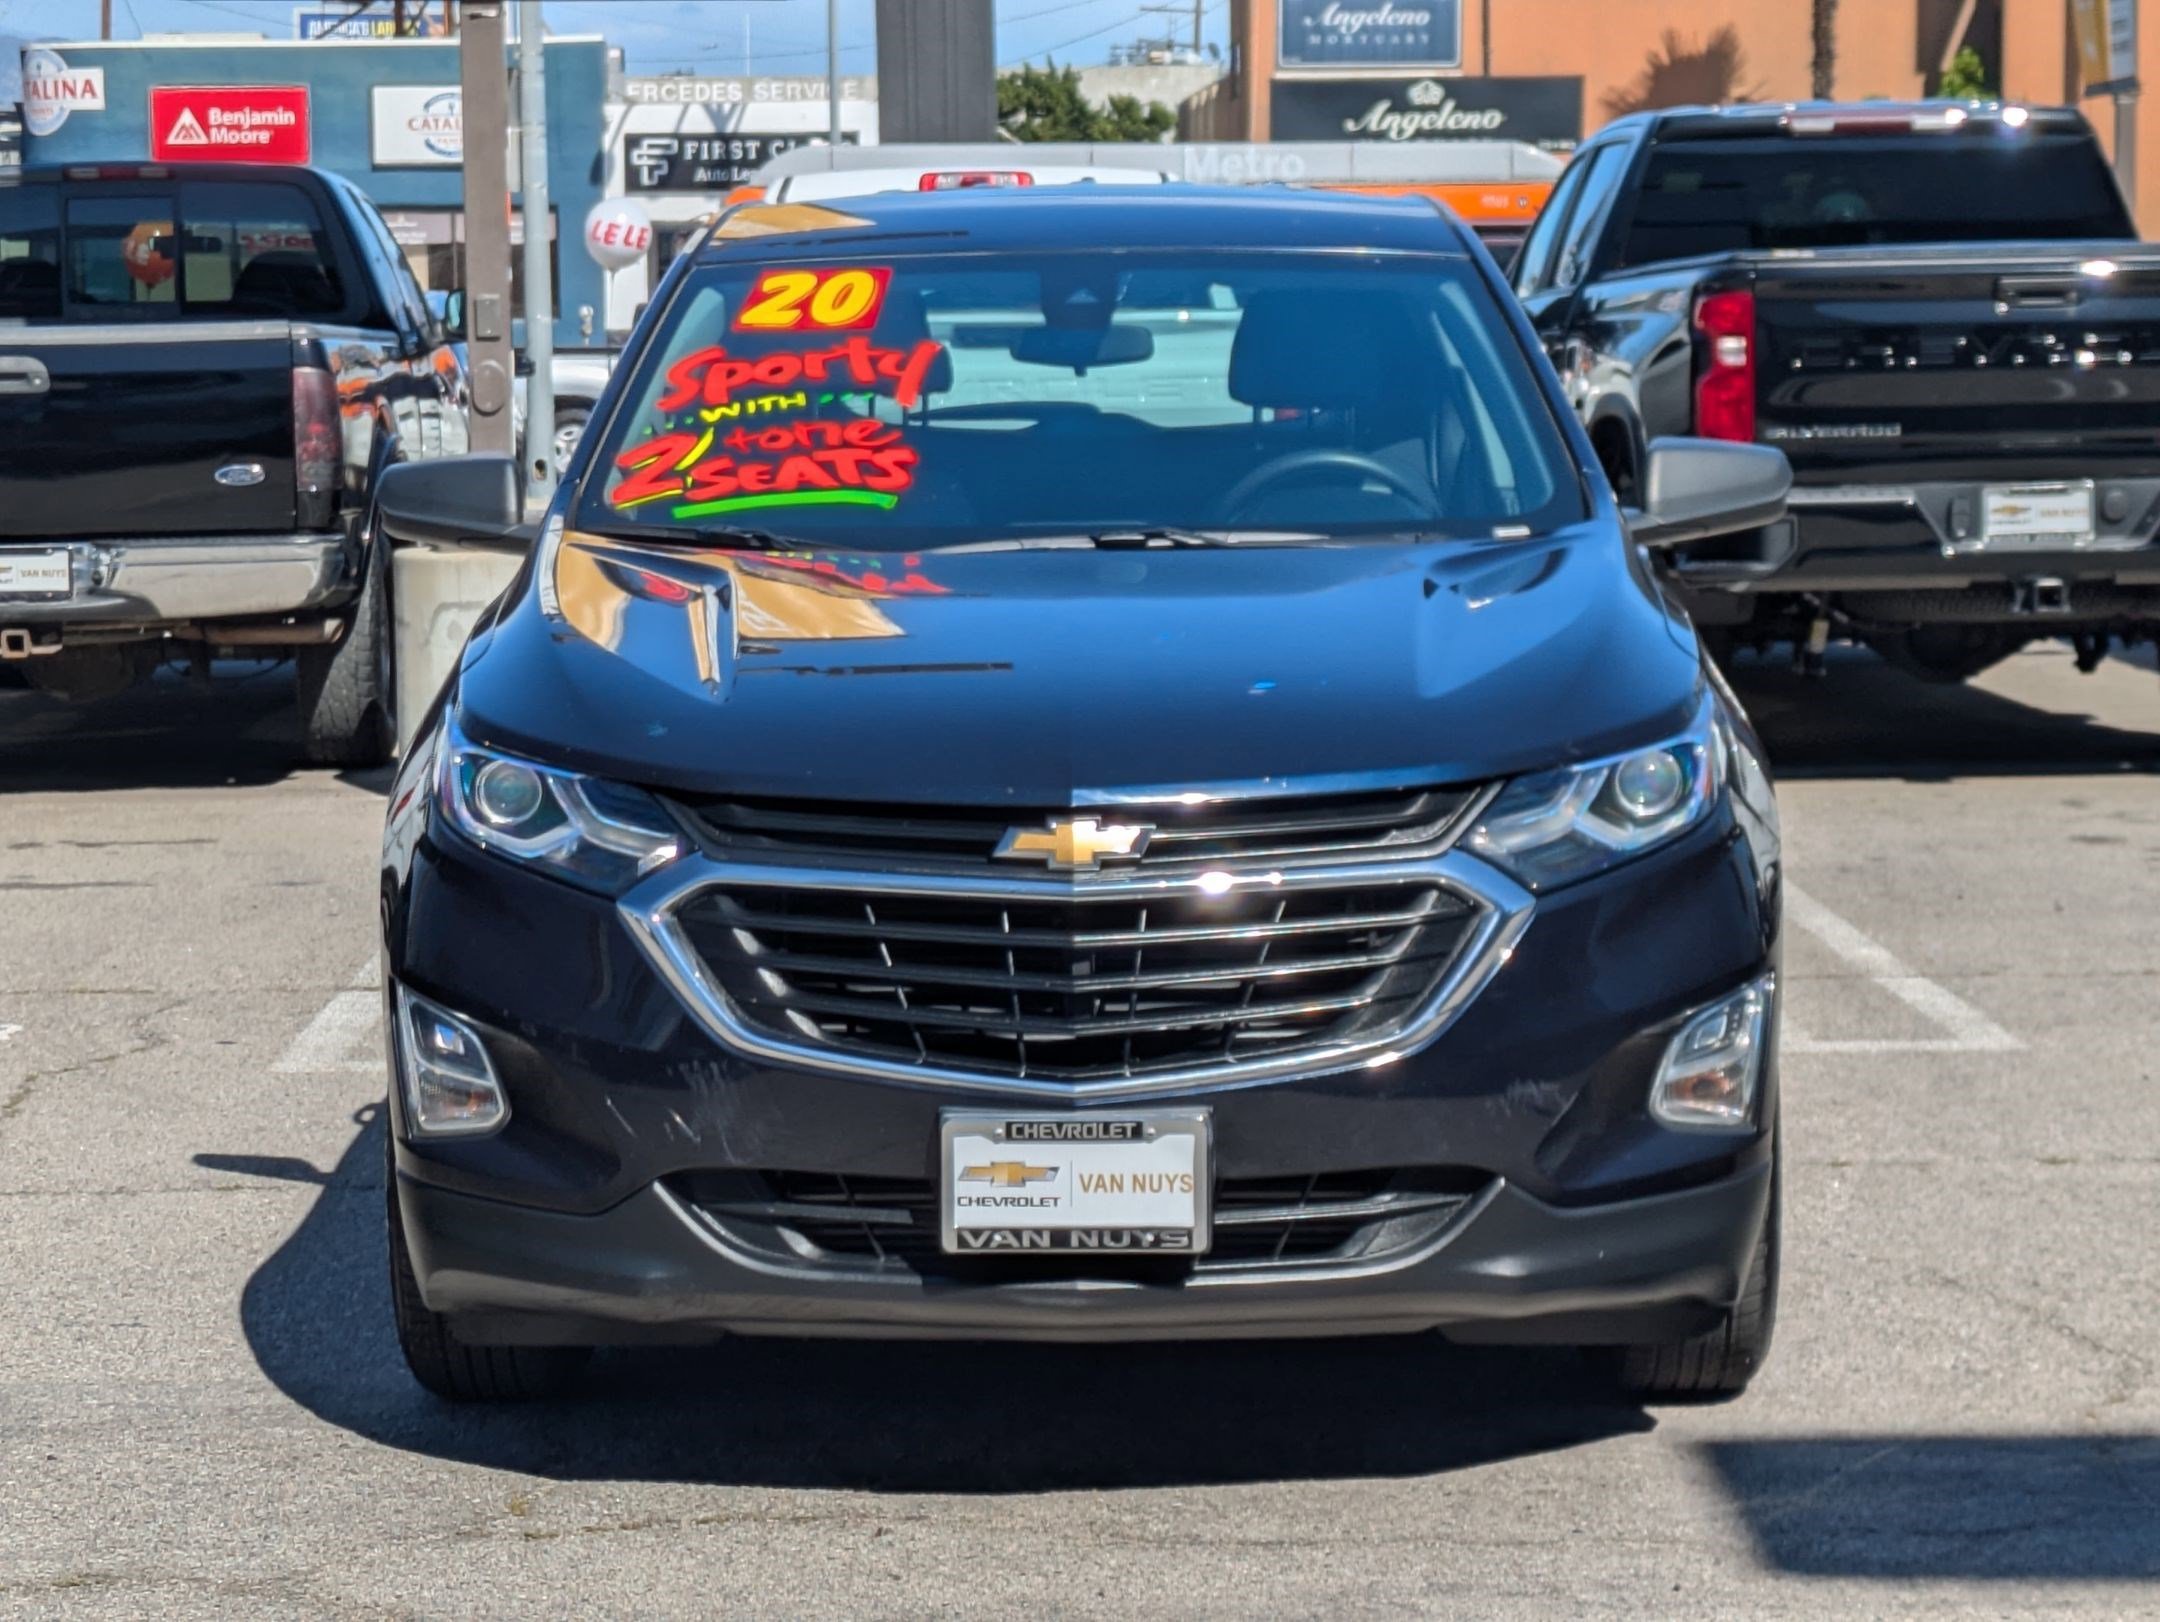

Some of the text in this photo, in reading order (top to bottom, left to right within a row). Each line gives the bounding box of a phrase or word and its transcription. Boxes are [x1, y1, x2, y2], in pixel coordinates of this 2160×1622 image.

[1303, 1, 1431, 34] Angeleno
[628, 81, 857, 101] ERCEDES SERVIE
[209, 106, 296, 130] Benjamin
[1344, 100, 1504, 141] Angeleno
[209, 128, 270, 145] Moore
[683, 140, 760, 160] FIRST
[1185, 145, 1304, 180] Metro
[694, 166, 730, 183] Auto
[741, 271, 878, 327] 20
[701, 392, 807, 422] WITH
[685, 448, 919, 499] SEATS
[1011, 1122, 1137, 1139] CHEVROLET
[1079, 1173, 1194, 1193] VAN NUYS
[957, 1196, 1062, 1208] CHEVROLET
[963, 1229, 1190, 1248] VAN NUYS
